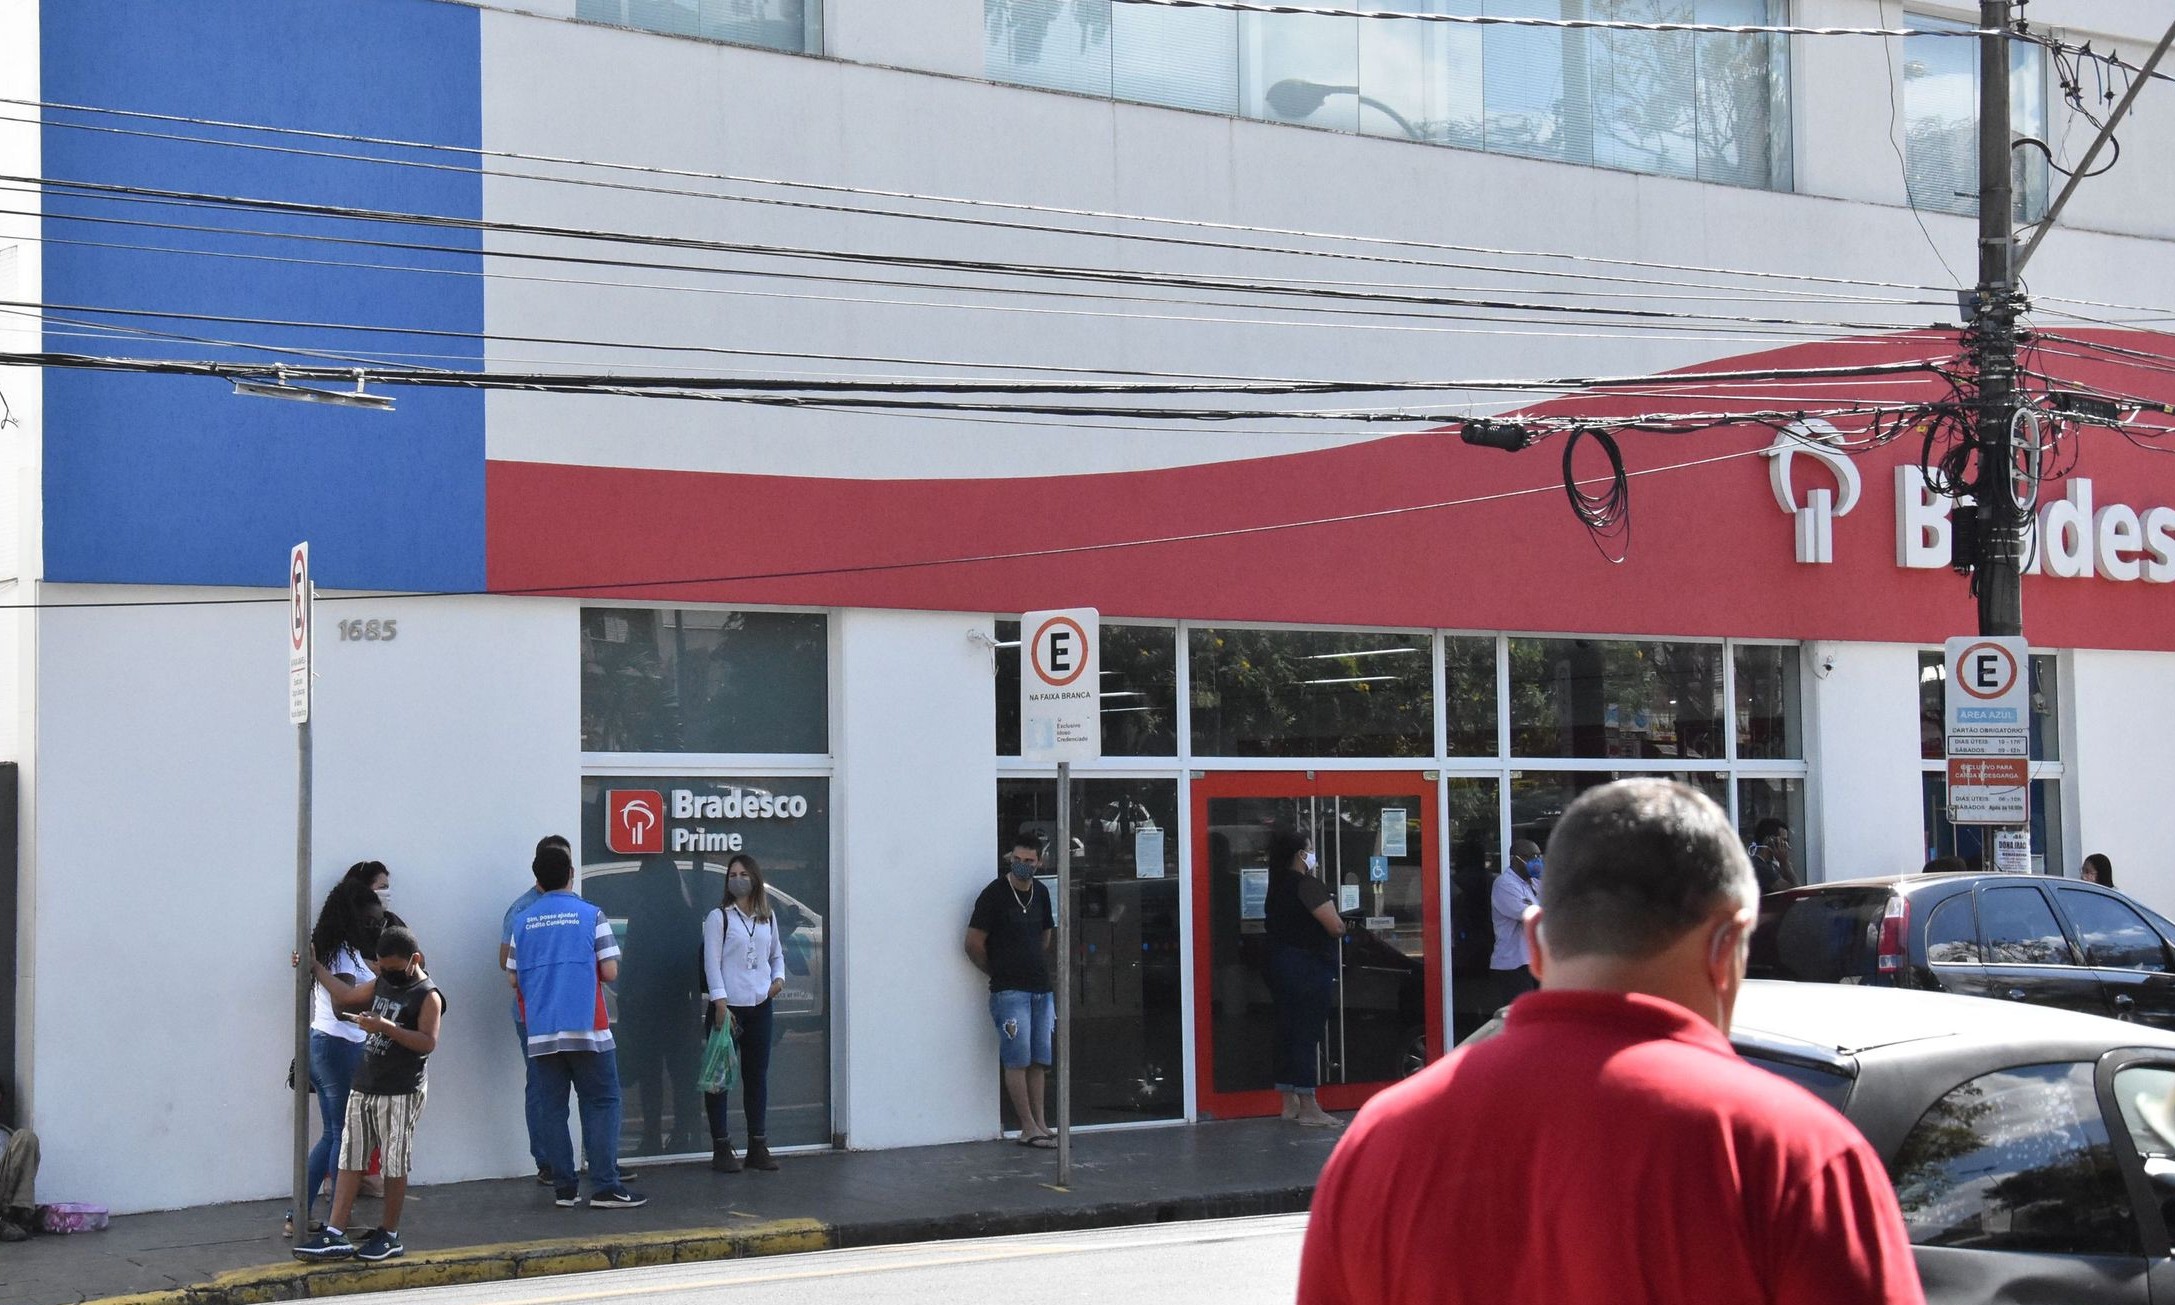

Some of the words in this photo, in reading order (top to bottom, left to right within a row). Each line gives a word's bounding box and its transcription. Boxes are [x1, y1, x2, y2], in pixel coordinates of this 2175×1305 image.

[1894, 464, 2175, 583] Bdes
[338, 619, 397, 641] 1685
[1050, 632, 1070, 671] E
[1977, 655, 1998, 687] E
[1040, 692, 1060, 700] FAIXA
[1061, 691, 1091, 700] BRANCA
[1989, 711, 2013, 719] AZUL
[671, 788, 807, 819] Bradesco
[671, 827, 743, 852] Prime
[546, 919, 580, 927] Consignado
